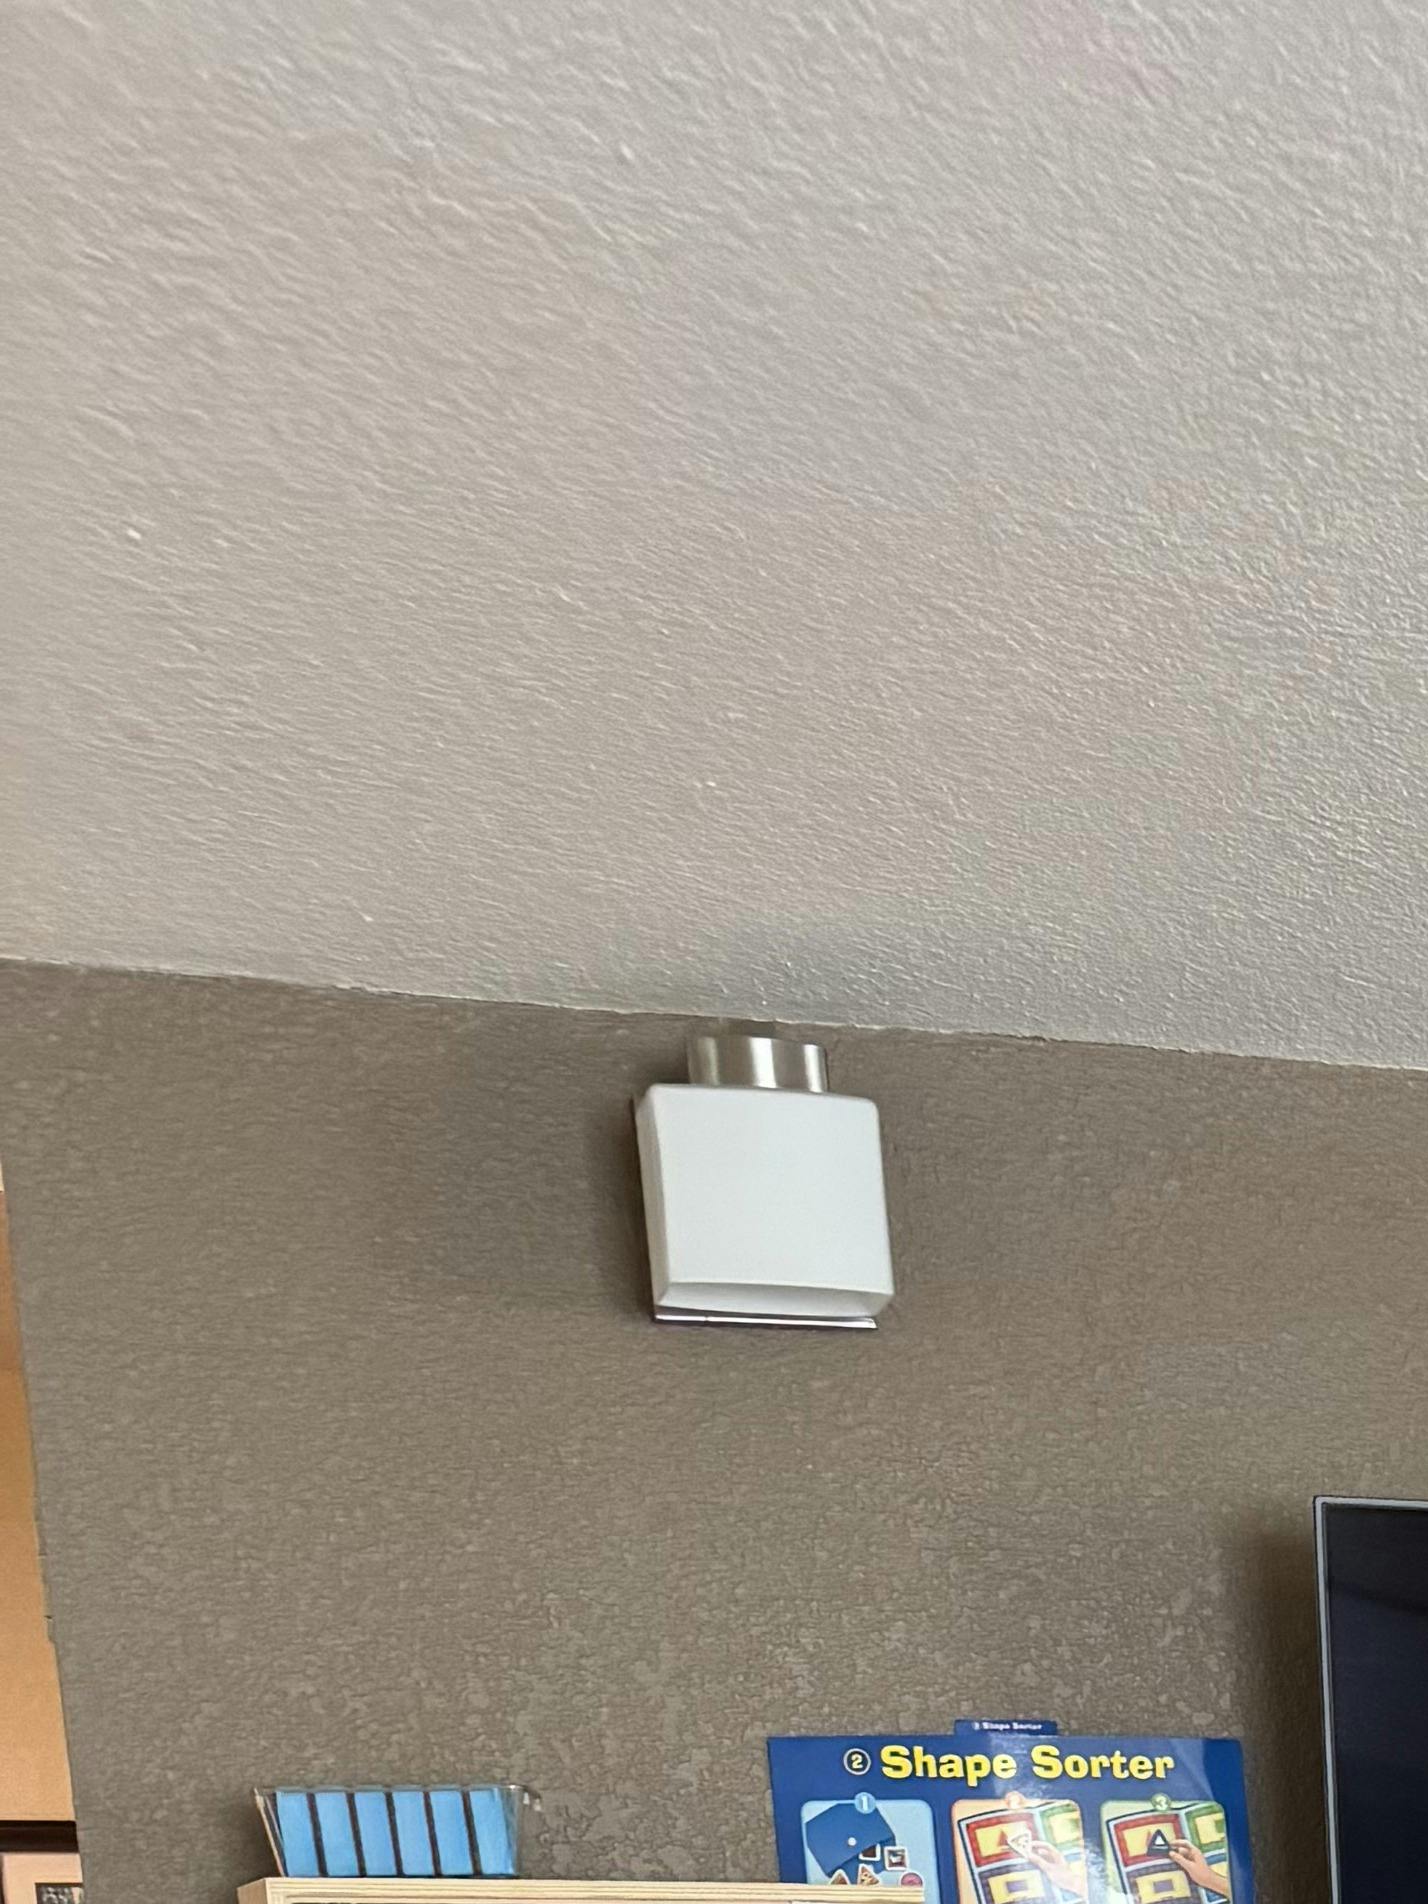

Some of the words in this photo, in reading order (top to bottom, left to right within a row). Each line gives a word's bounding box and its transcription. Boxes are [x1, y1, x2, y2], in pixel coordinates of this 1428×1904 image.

[851, 1754, 863, 1769] 2
[880, 1744, 1017, 1787] Shape
[1031, 1744, 1175, 1779] Sorter
